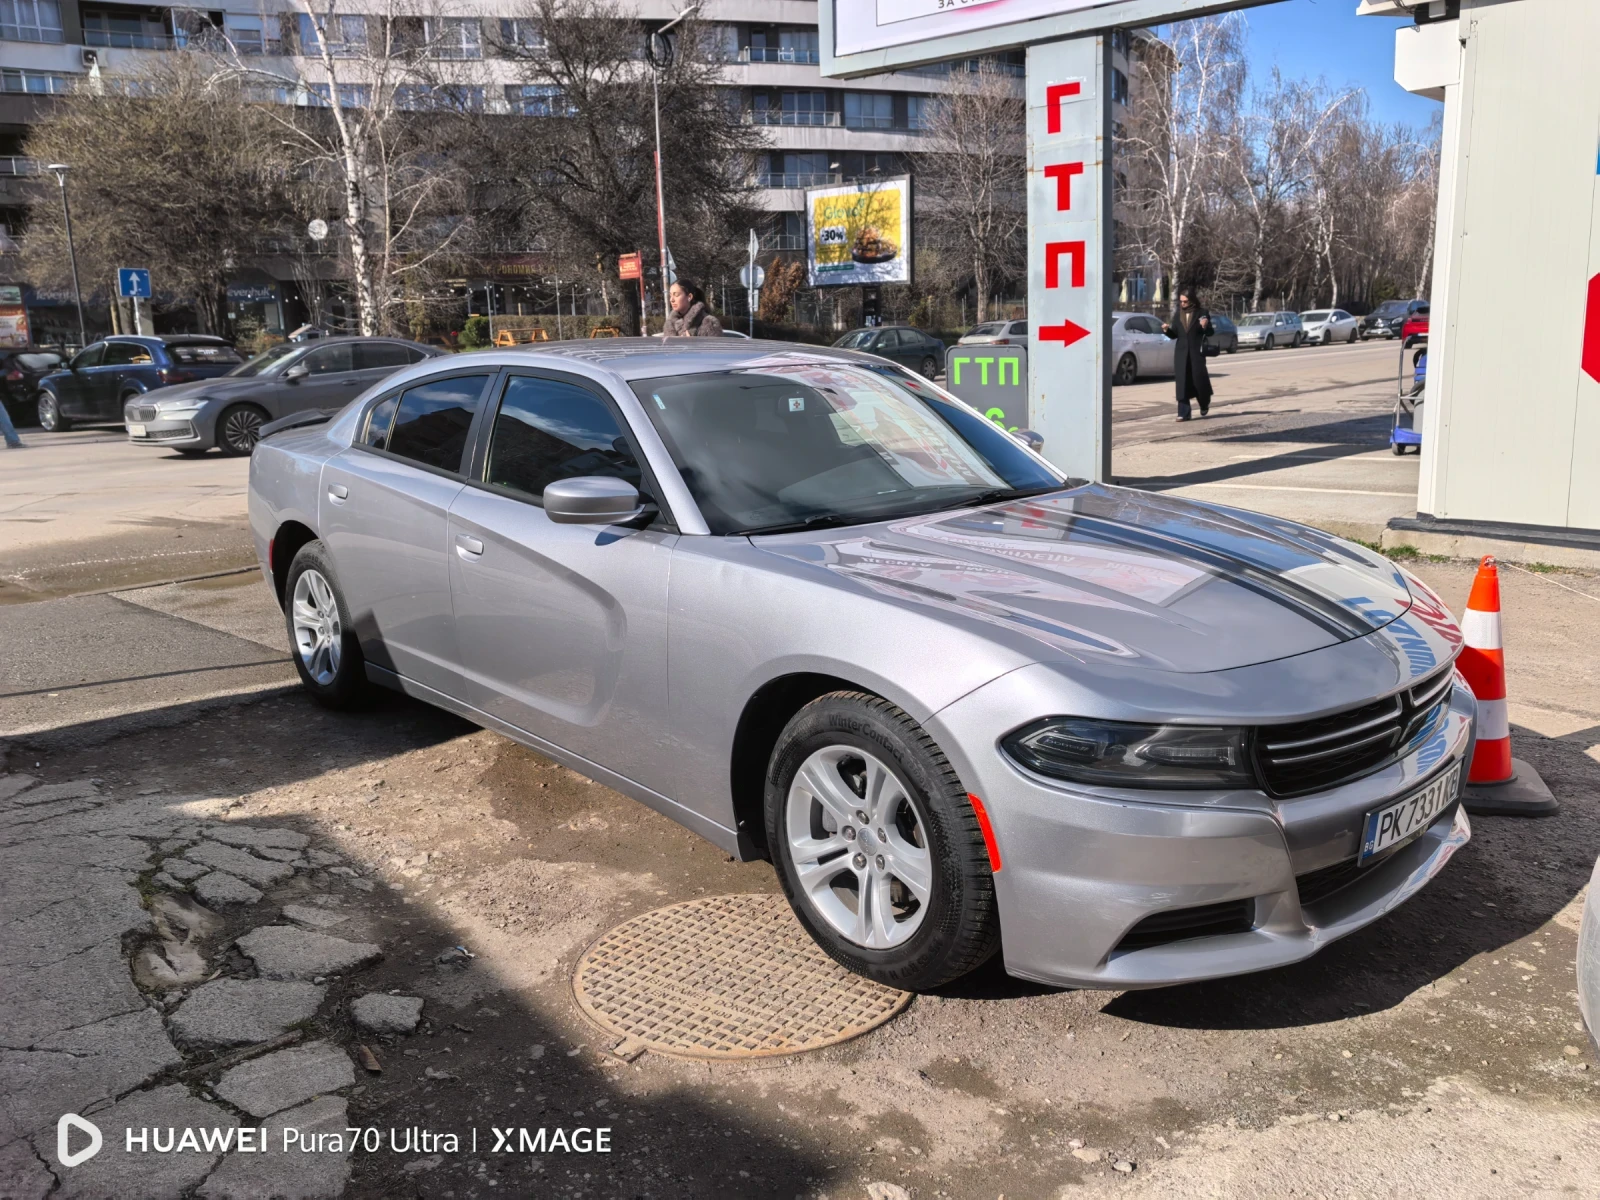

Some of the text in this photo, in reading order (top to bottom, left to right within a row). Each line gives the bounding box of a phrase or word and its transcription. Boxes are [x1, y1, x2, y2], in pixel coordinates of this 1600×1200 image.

[821, 229, 844, 242] -30%
[953, 357, 1019, 386] ГТП
[827, 713, 906, 764] WinterContact
[1377, 806, 1406, 848] PK
[1405, 780, 1443, 834] 7331
[1364, 840, 1375, 853] BG
